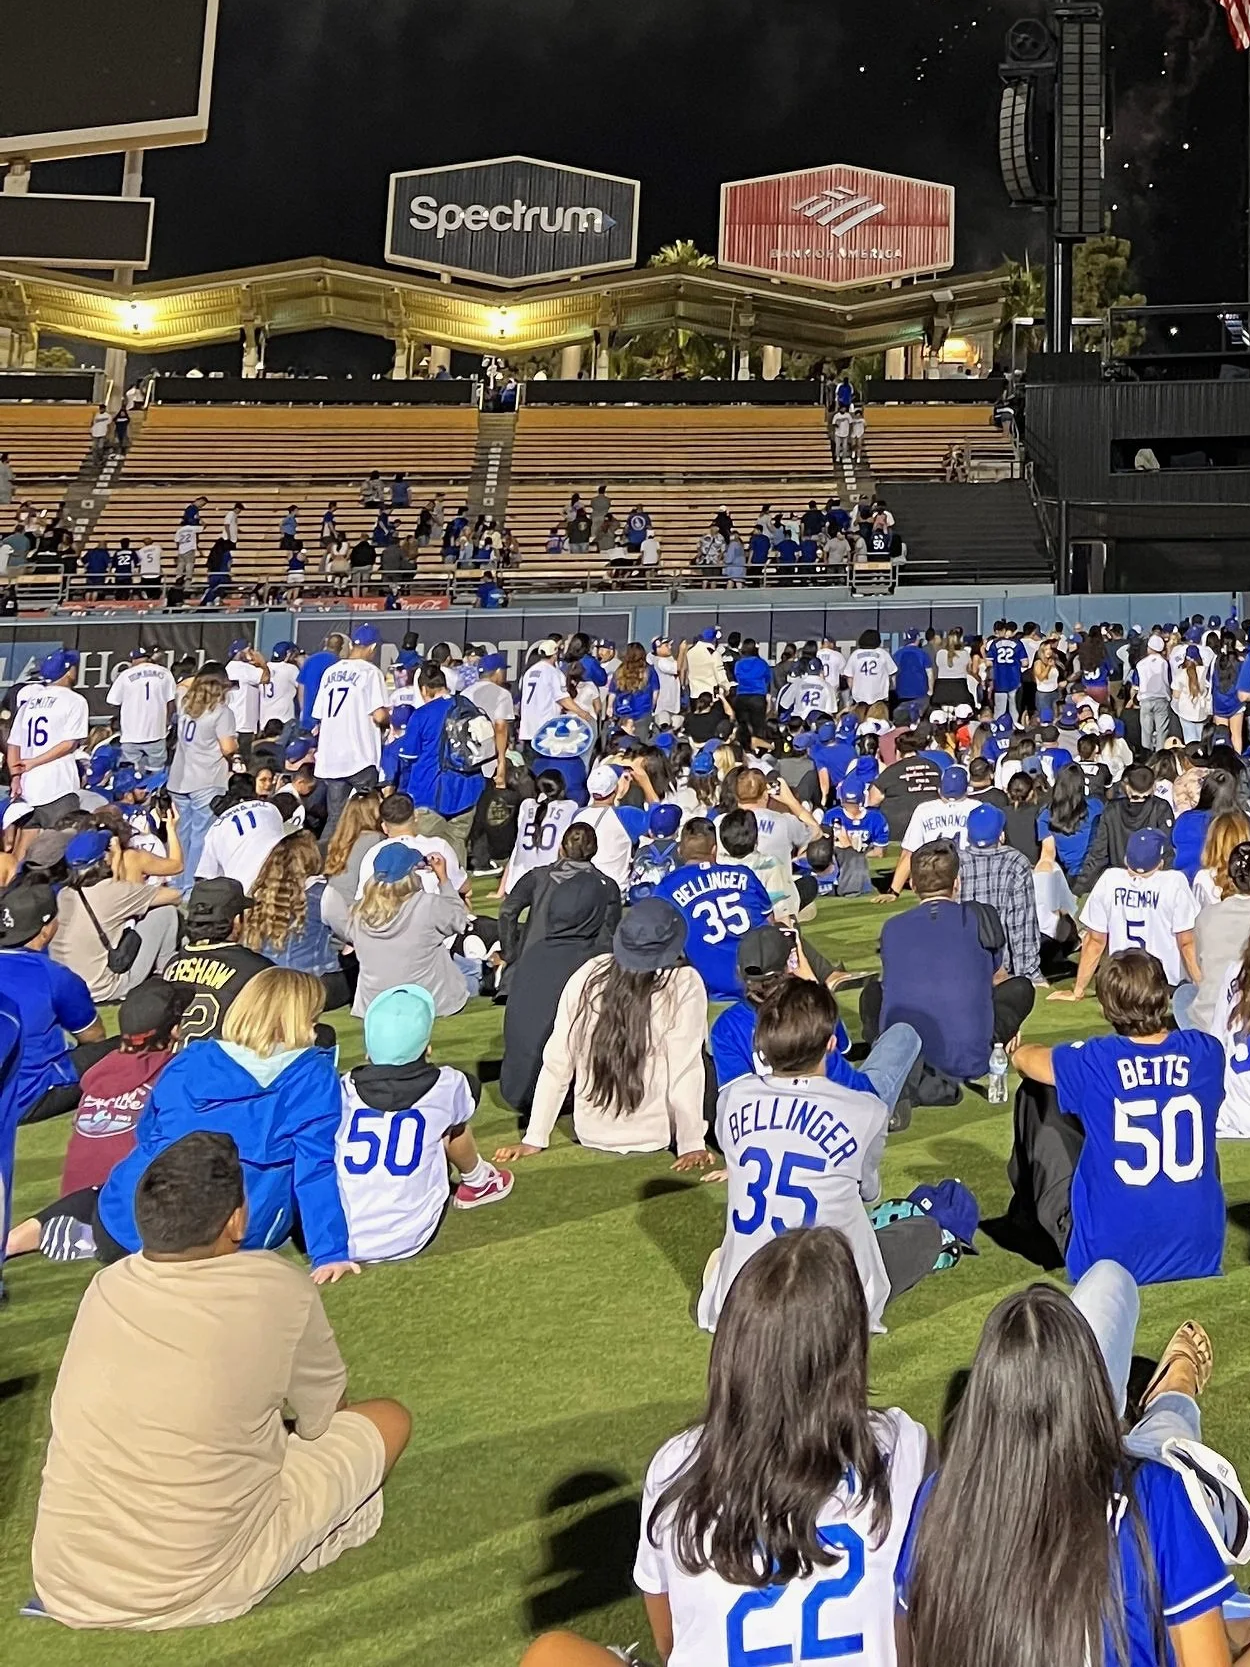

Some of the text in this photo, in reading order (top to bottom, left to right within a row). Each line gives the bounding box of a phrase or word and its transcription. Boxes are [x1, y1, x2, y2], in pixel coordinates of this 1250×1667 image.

[409, 195, 603, 239] Spectrum
[117, 555, 131, 566] 22
[860, 660, 878, 676] 42
[996, 647, 1015, 664] 22
[28, 696, 58, 710] SMITH
[144, 681, 150, 701] 1
[328, 687, 349, 718] 17
[526, 682, 537, 705] 7
[800, 690, 821, 708] 42
[26, 716, 48, 747] 16
[232, 810, 257, 837] 11
[527, 805, 562, 820] BTS
[522, 823, 558, 851] 50
[672, 871, 748, 908] BELLINGER
[692, 891, 750, 945] 35
[1126, 921, 1146, 950] 5
[1118, 1054, 1190, 1091] BETTS
[343, 1107, 427, 1177] 50
[728, 1096, 859, 1168] BELLINGER
[1112, 1094, 1206, 1186] 50
[731, 1147, 827, 1237] 35
